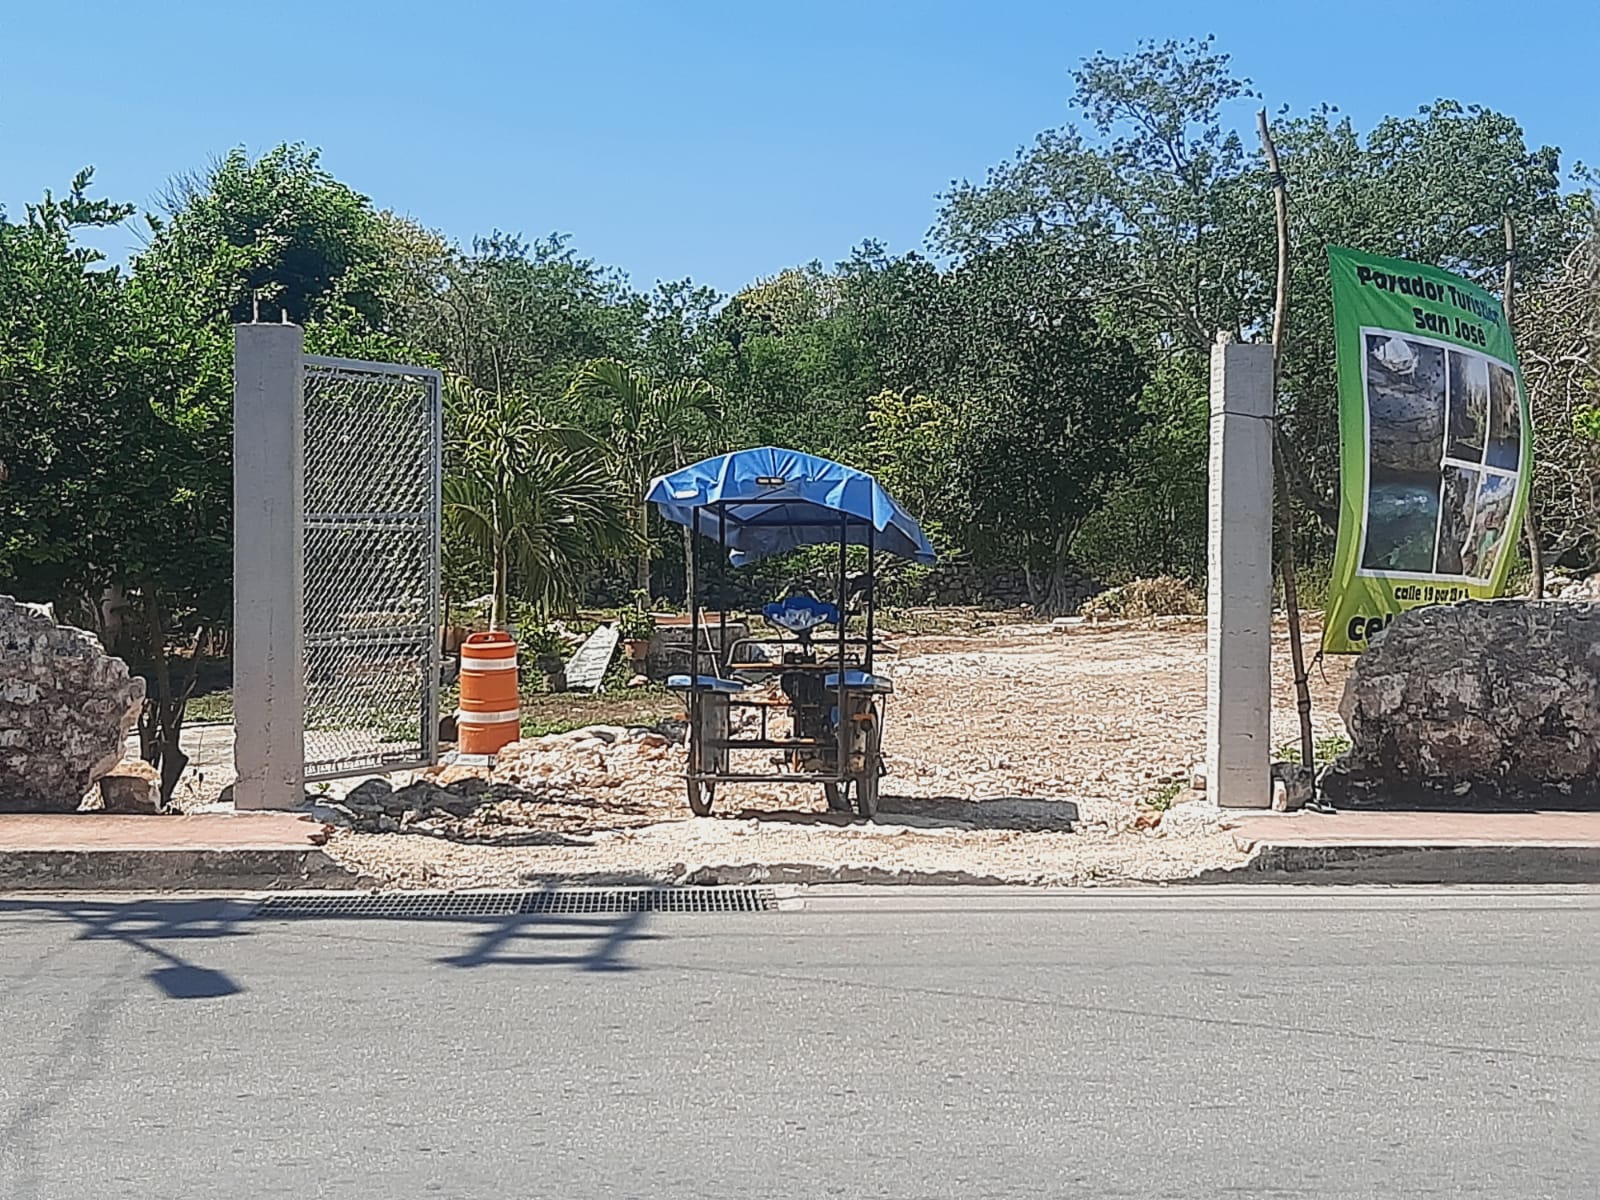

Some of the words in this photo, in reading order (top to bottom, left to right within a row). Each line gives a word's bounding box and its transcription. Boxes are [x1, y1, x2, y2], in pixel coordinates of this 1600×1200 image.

[1356, 265, 1446, 302] Parador
[1412, 307, 1450, 335] San
[1453, 317, 1486, 347] José
[1394, 585, 1421, 600] calle
[1435, 588, 1448, 603] por
